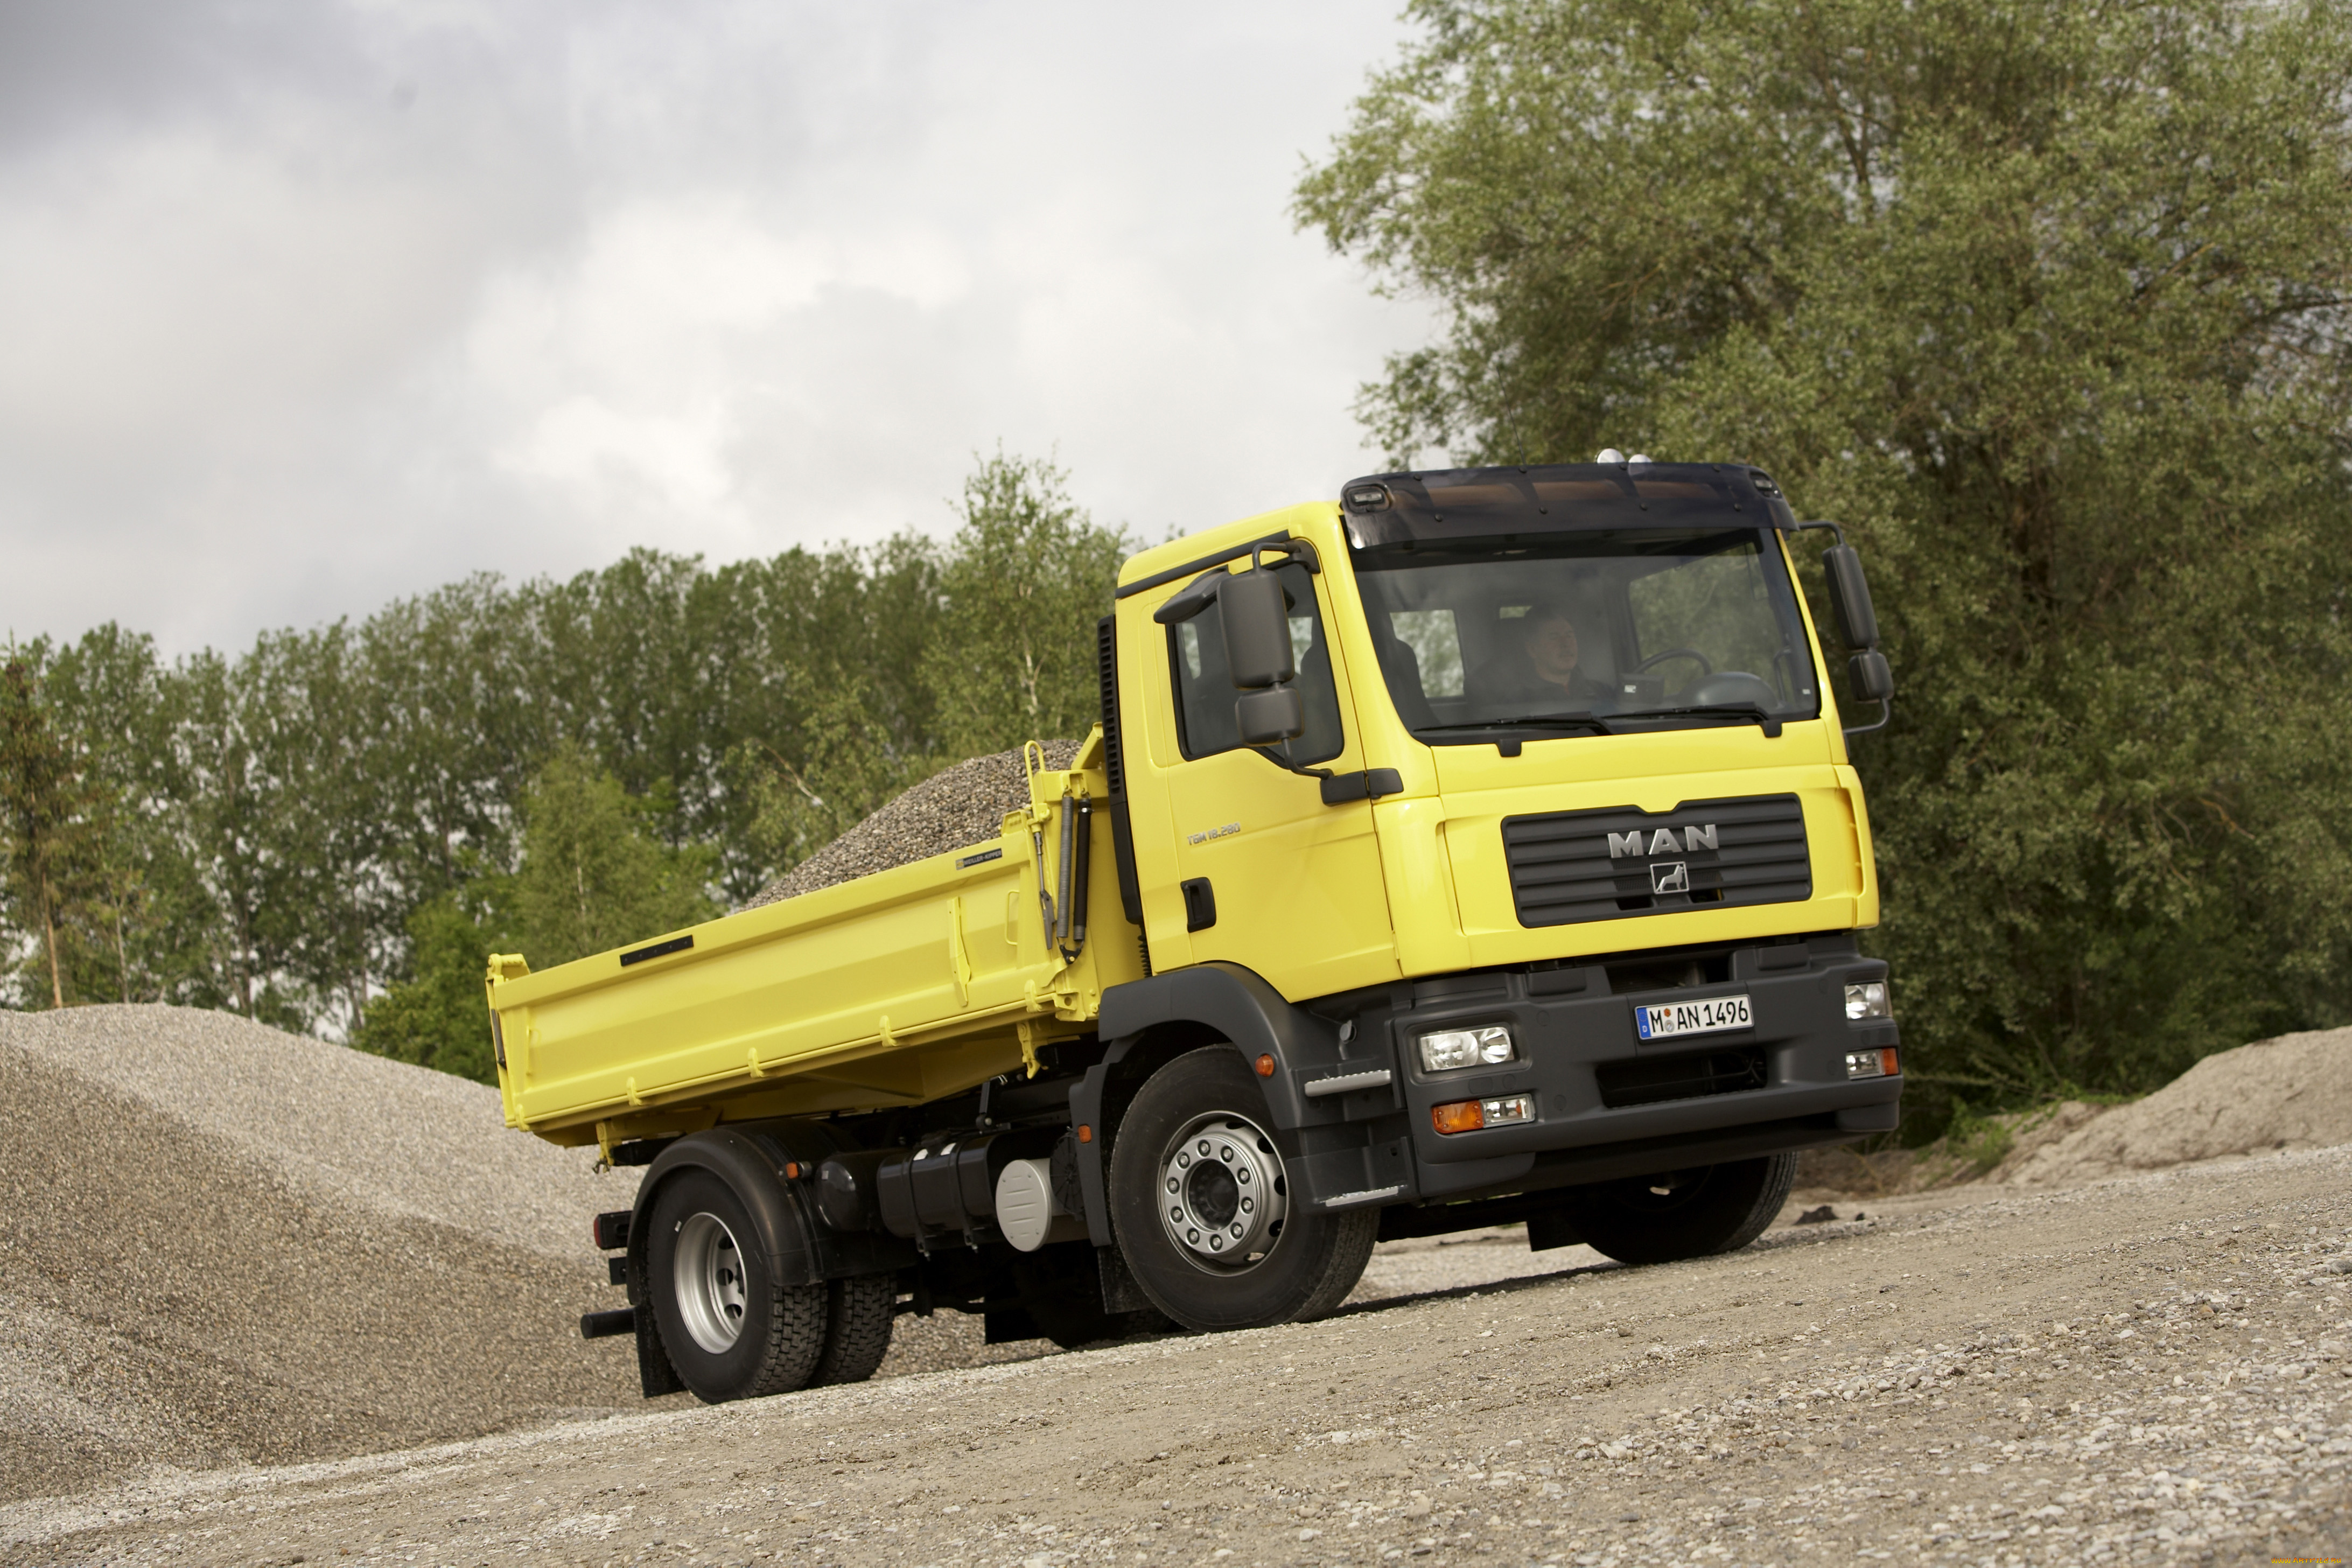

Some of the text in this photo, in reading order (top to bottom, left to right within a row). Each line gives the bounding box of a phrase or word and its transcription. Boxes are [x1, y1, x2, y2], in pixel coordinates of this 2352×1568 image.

[1208, 821, 1241, 839] 18.280
[1607, 824, 1719, 858] MAN
[1649, 1000, 1748, 1032] M AN 1496
